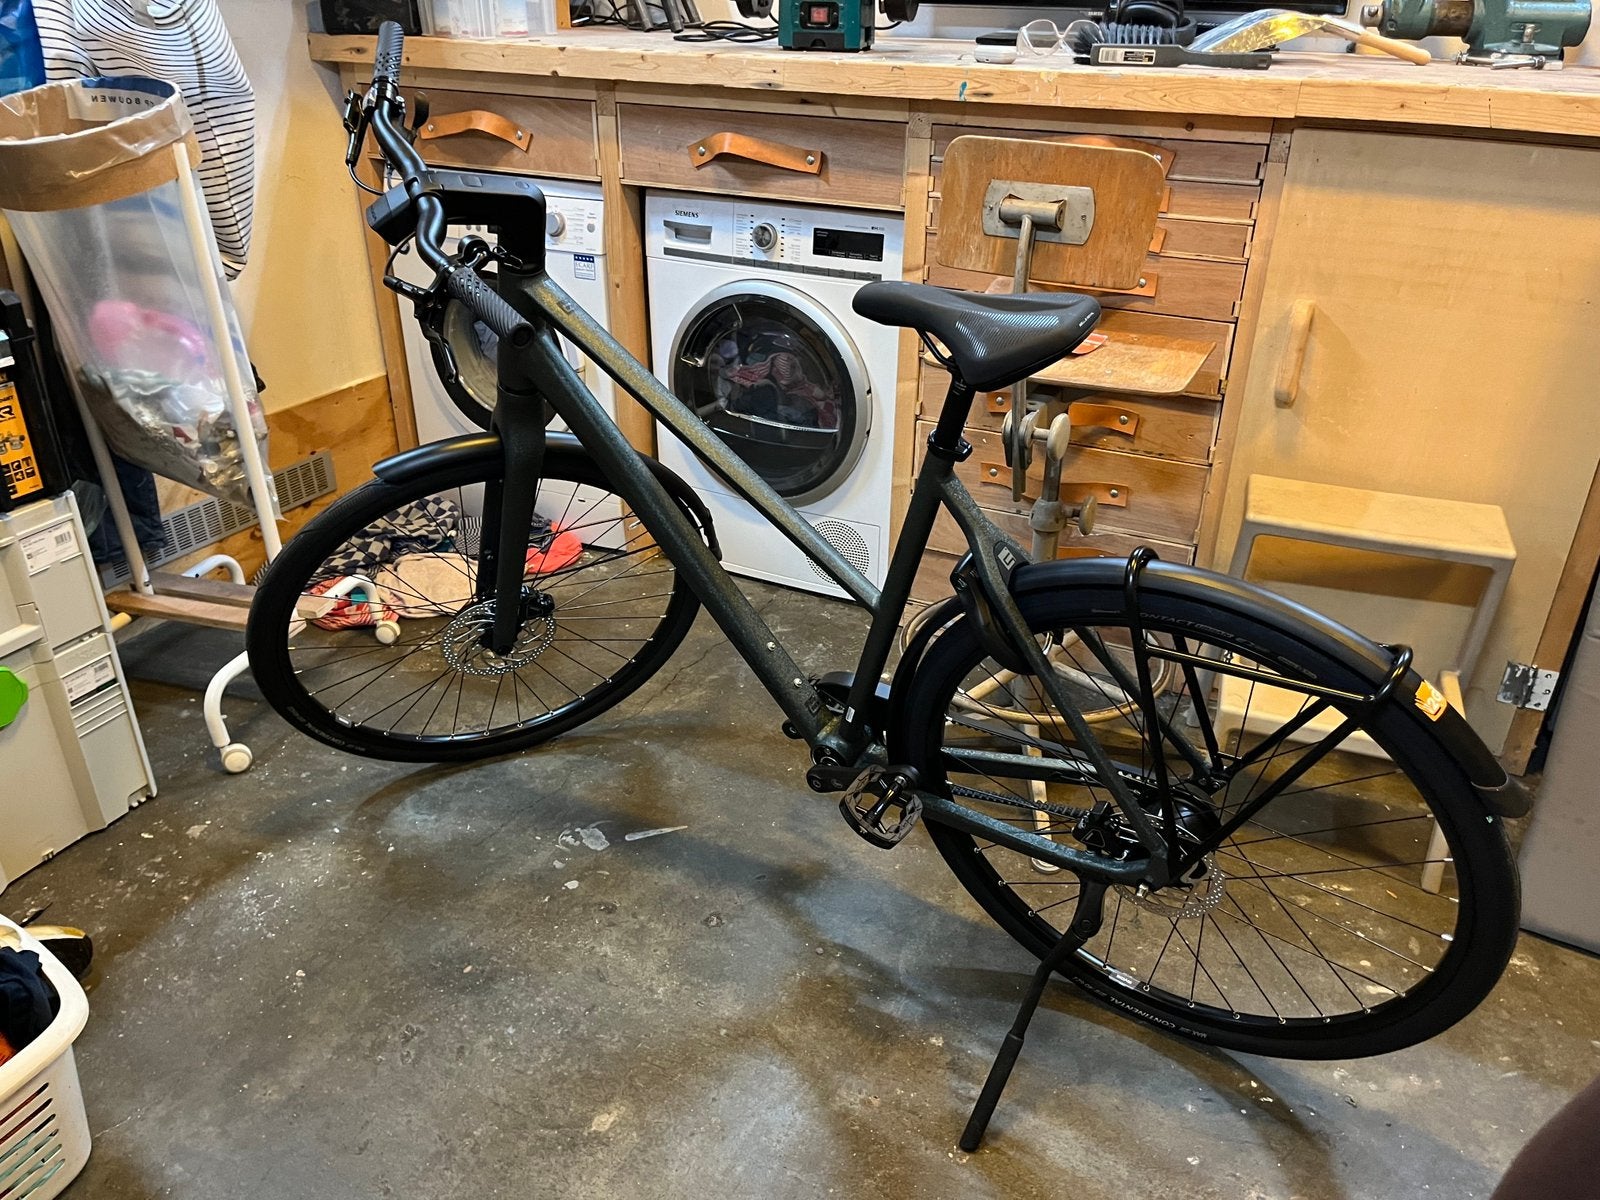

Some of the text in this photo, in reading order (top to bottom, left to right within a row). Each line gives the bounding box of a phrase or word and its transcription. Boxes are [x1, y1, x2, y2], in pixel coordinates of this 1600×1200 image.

[674, 209, 699, 218] SIEMENS
[1139, 611, 1196, 627] ONTACT
[1109, 996, 1176, 1029] CONTINENTAL
